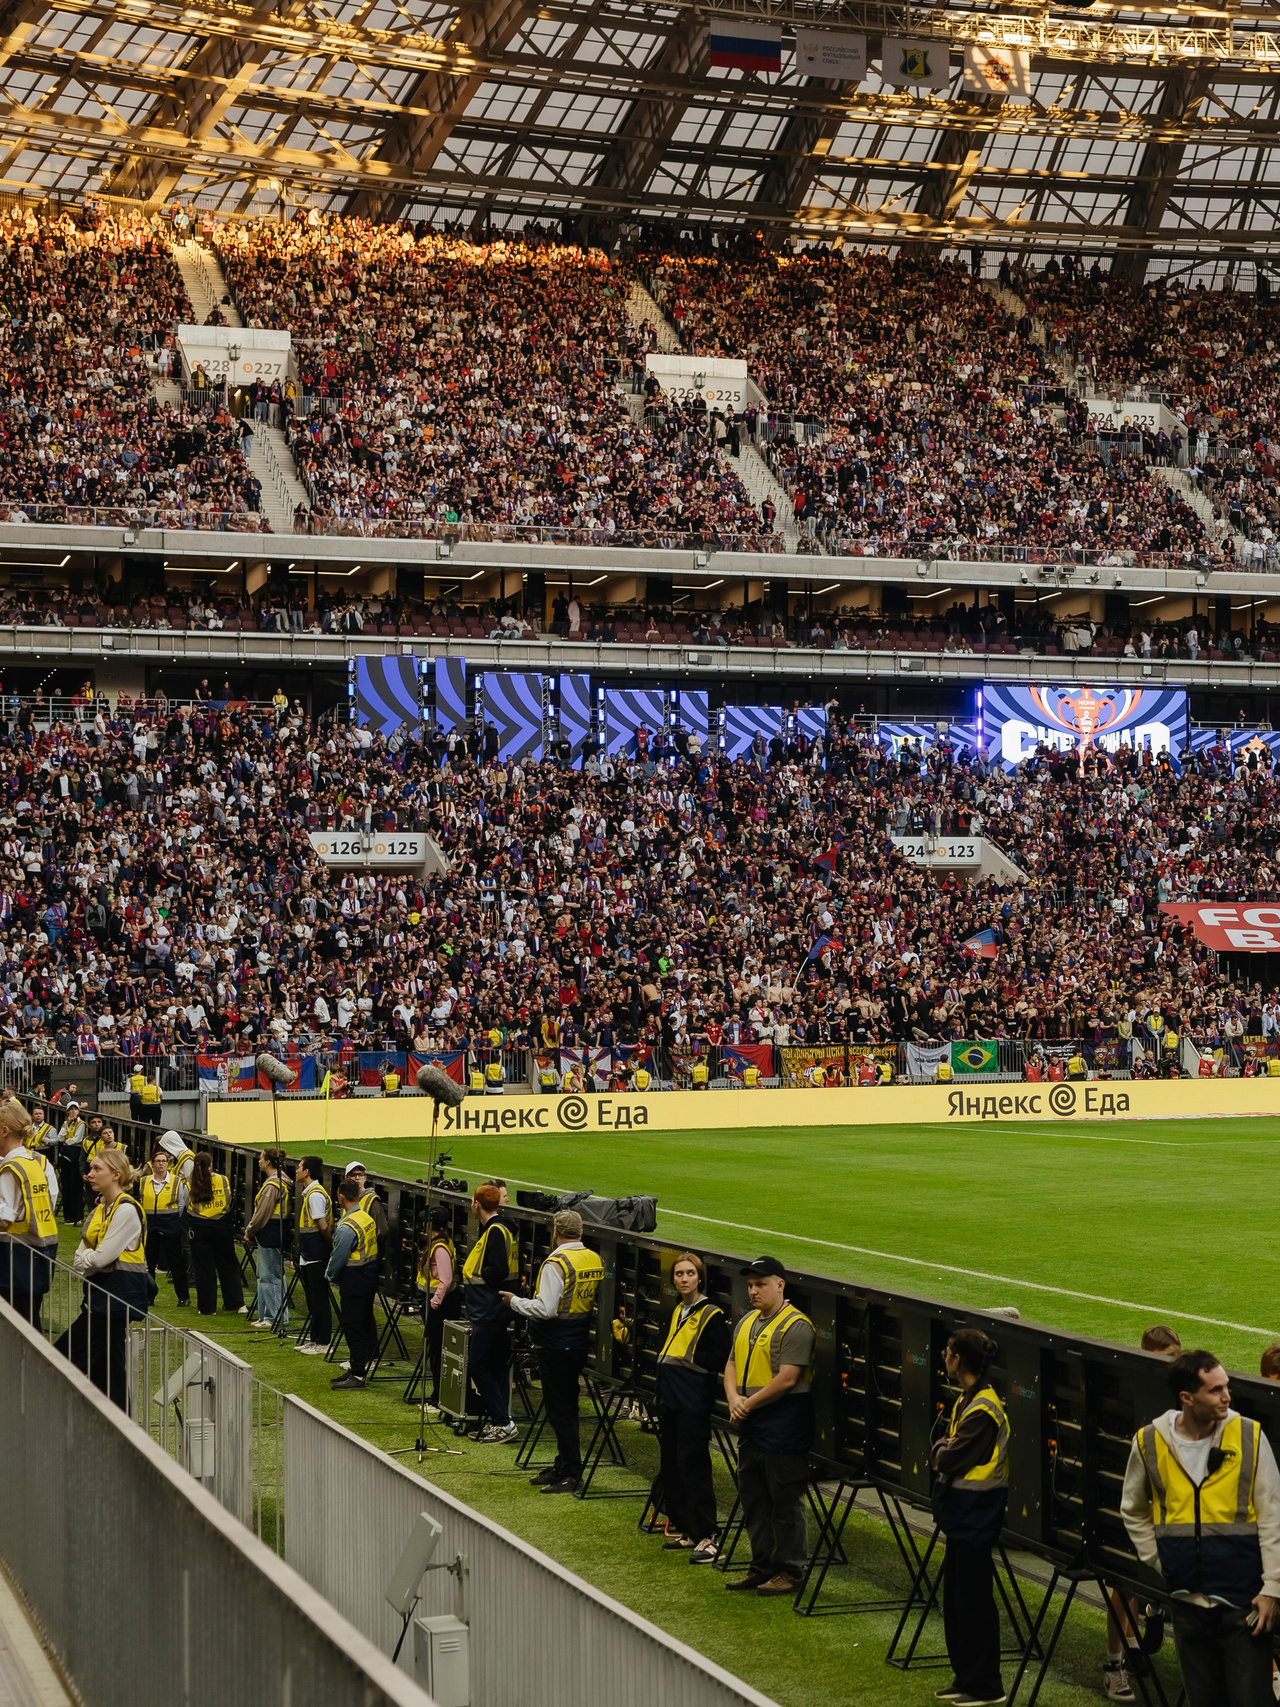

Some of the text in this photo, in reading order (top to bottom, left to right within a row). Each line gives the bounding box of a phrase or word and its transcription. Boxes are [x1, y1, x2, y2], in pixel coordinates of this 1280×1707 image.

[203, 359, 230, 372] 228
[254, 362, 282, 375] 227
[669, 387, 695, 399] 226
[716, 390, 741, 402] 225
[330, 841, 361, 855] 126
[388, 842, 418, 855] 125
[898, 845, 925, 857] 124
[948, 845, 975, 857] 123
[948, 1088, 1130, 1118] Яндекс Еда
[443, 1099, 649, 1133] Яндекс Еда
[578, 1269, 604, 1280] SAFETY
[577, 1287, 594, 1300] K04
